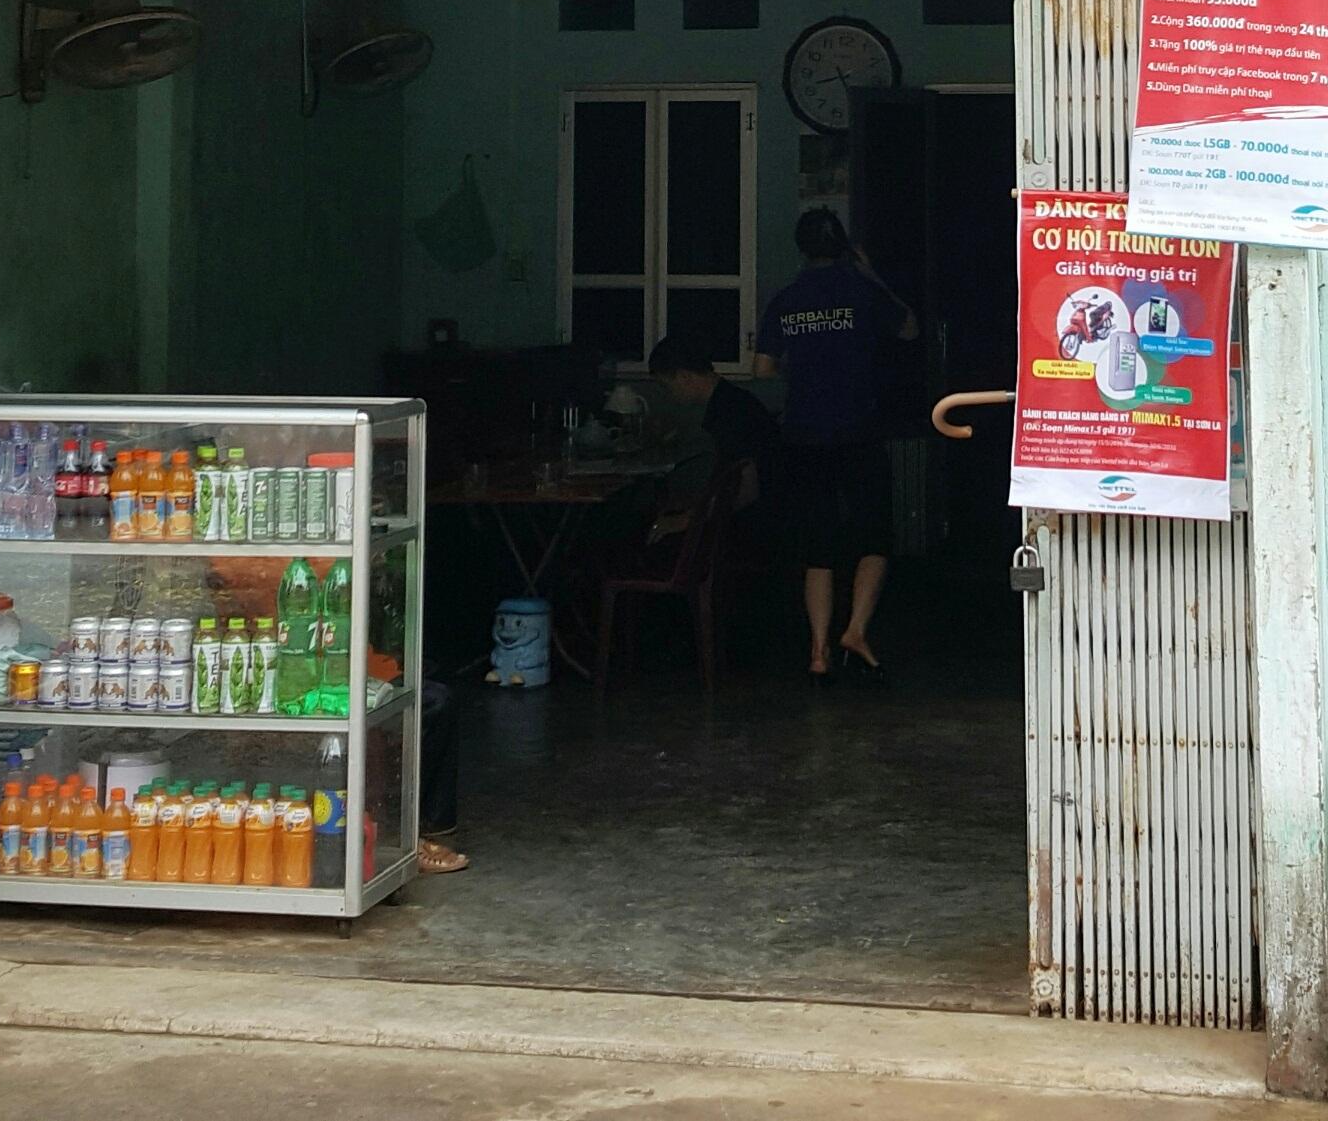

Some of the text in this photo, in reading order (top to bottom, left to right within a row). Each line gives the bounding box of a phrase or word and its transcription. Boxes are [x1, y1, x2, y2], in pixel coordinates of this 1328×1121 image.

[1186, 15, 1245, 29] 360.000đ
[1247, 21, 1272, 34] trong
[1273, 24, 1298, 36] vòng
[1299, 23, 1314, 35] 24
[1183, 39, 1217, 51] 100%
[1219, 42, 1233, 54] giá
[1235, 44, 1246, 55] trị
[1264, 47, 1283, 58] nạp
[1181, 64, 1197, 75] phí
[1198, 66, 1217, 76] truy
[1218, 65, 1236, 78] cập
[1237, 67, 1281, 79] Facebook
[1283, 72, 1309, 84] trong
[1310, 71, 1318, 83] 7
[1183, 83, 1204, 93] Data
[1205, 84, 1229, 95] miễn
[1230, 86, 1246, 97] phí
[1248, 88, 1273, 100] thoại
[1205, 168, 1227, 179] 2GB
[1035, 198, 1099, 219] ĐĂNG
[1032, 227, 1061, 250] CƠ
[1066, 225, 1103, 255] HỘI
[1055, 260, 1197, 286] Giải thưởng giá trị
[780, 308, 854, 326] HERBALIFE
[783, 319, 854, 337] NUTRITION
[1132, 411, 1181, 427] MIMAX1.5
